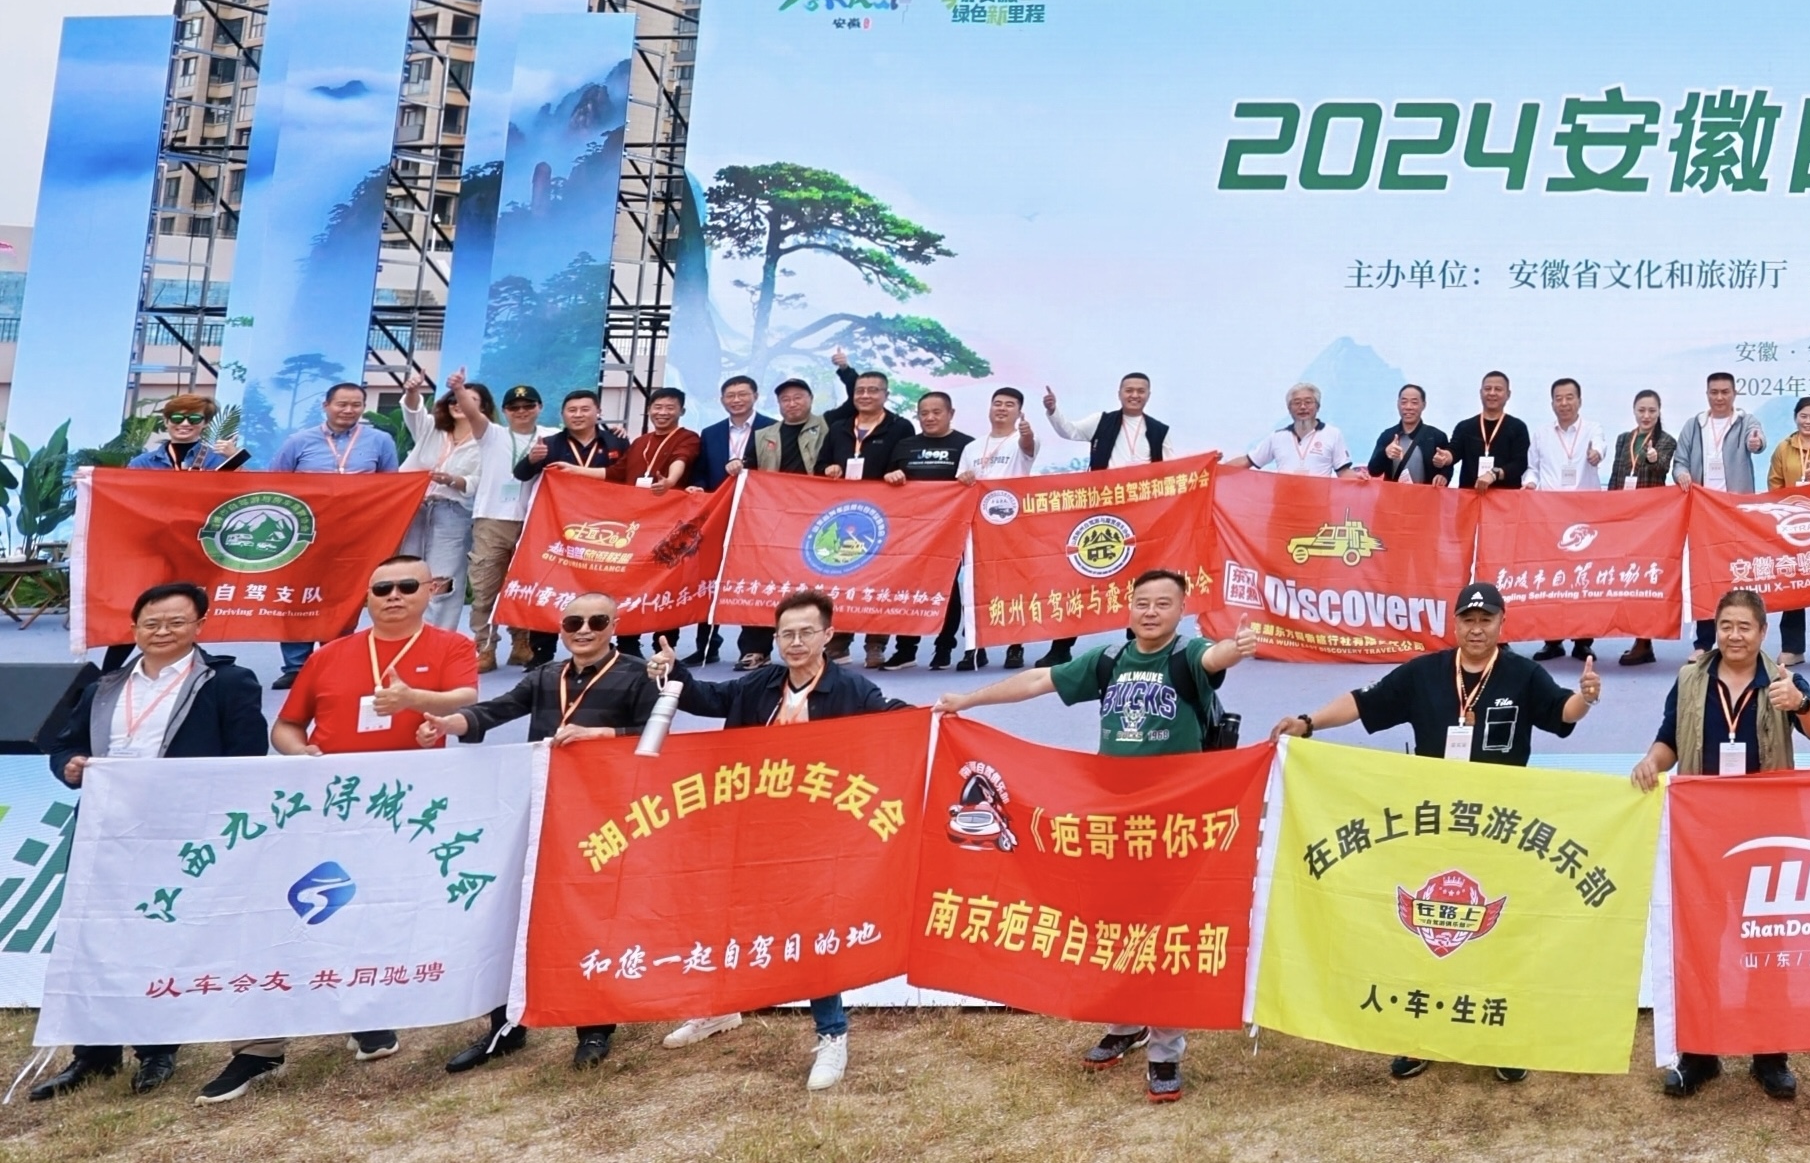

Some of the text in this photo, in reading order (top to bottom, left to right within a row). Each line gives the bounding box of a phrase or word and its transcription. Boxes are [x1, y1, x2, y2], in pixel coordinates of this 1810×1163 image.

[952, 4, 1045, 26] 绿色新里程
[1508, 258, 1788, 291] 安徽省文化和旅游厅
[918, 449, 949, 461] Jeep
[1023, 468, 1210, 514] 山西省旅游协会自驾游和露营分会
[198, 583, 323, 604] 自驾支队
[1264, 575, 1447, 638] Discovery
[1529, 591, 1580, 602] Self-driving
[1582, 590, 1604, 599] Tour
[1605, 589, 1664, 599] Association
[214, 607, 253, 617] Driving
[846, 606, 883, 615] TOURISM
[884, 607, 940, 618] ASSOCIATION
[1256, 637, 1275, 646] HINA
[1276, 639, 1300, 649] WUHU
[1318, 645, 1363, 655] DISCOVERY
[1364, 646, 1399, 656] TRAVEL
[1100, 681, 1177, 720] BUCKS
[578, 758, 906, 874] 湖北目的地车友会
[1303, 800, 1617, 909] 在路上自驾游俱乐部
[1416, 902, 1481, 921] 在路上
[925, 888, 1230, 977] 南京疤哥自驾游俱乐部
[580, 921, 882, 981] 和您一起自驾目的地
[145, 961, 446, 999] 以车会友 共同驰骋
